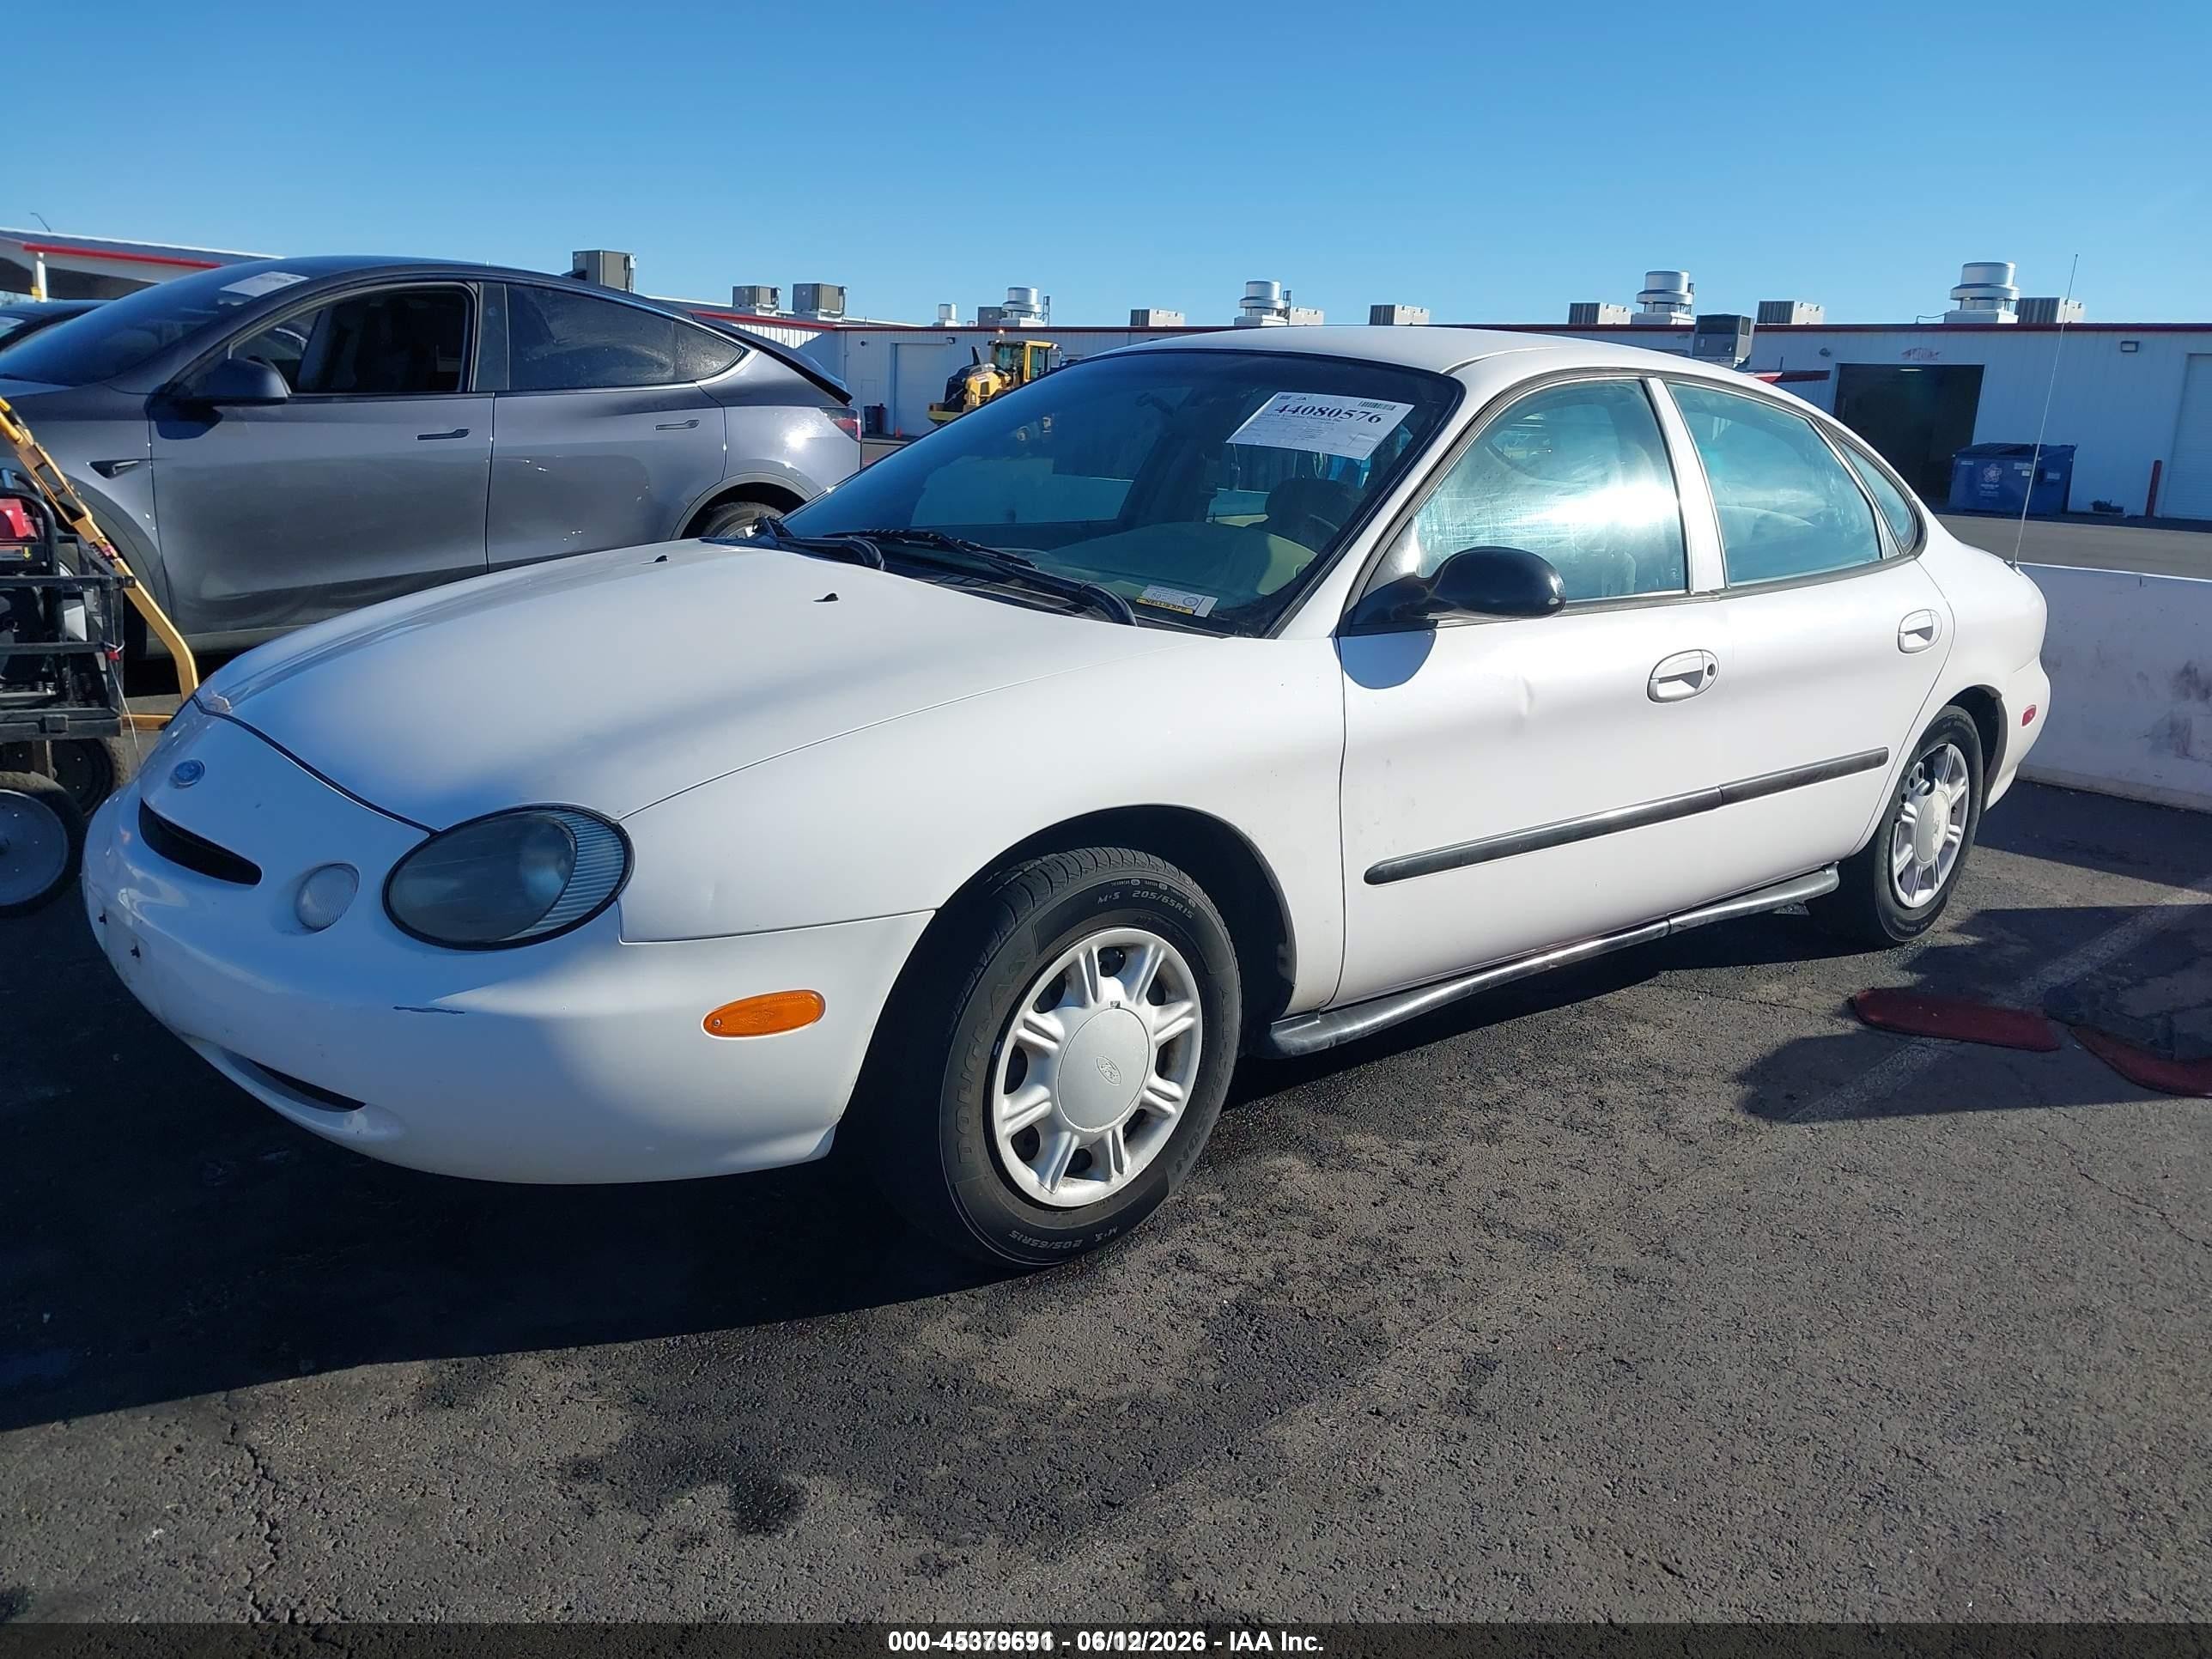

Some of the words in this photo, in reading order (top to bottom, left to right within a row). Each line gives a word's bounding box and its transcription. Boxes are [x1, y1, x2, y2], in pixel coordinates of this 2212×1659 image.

[1274, 404, 1388, 424] 44080576
[1132, 890, 1194, 920] 205/65R15
[1008, 1230, 1085, 1250] 205/65R15
